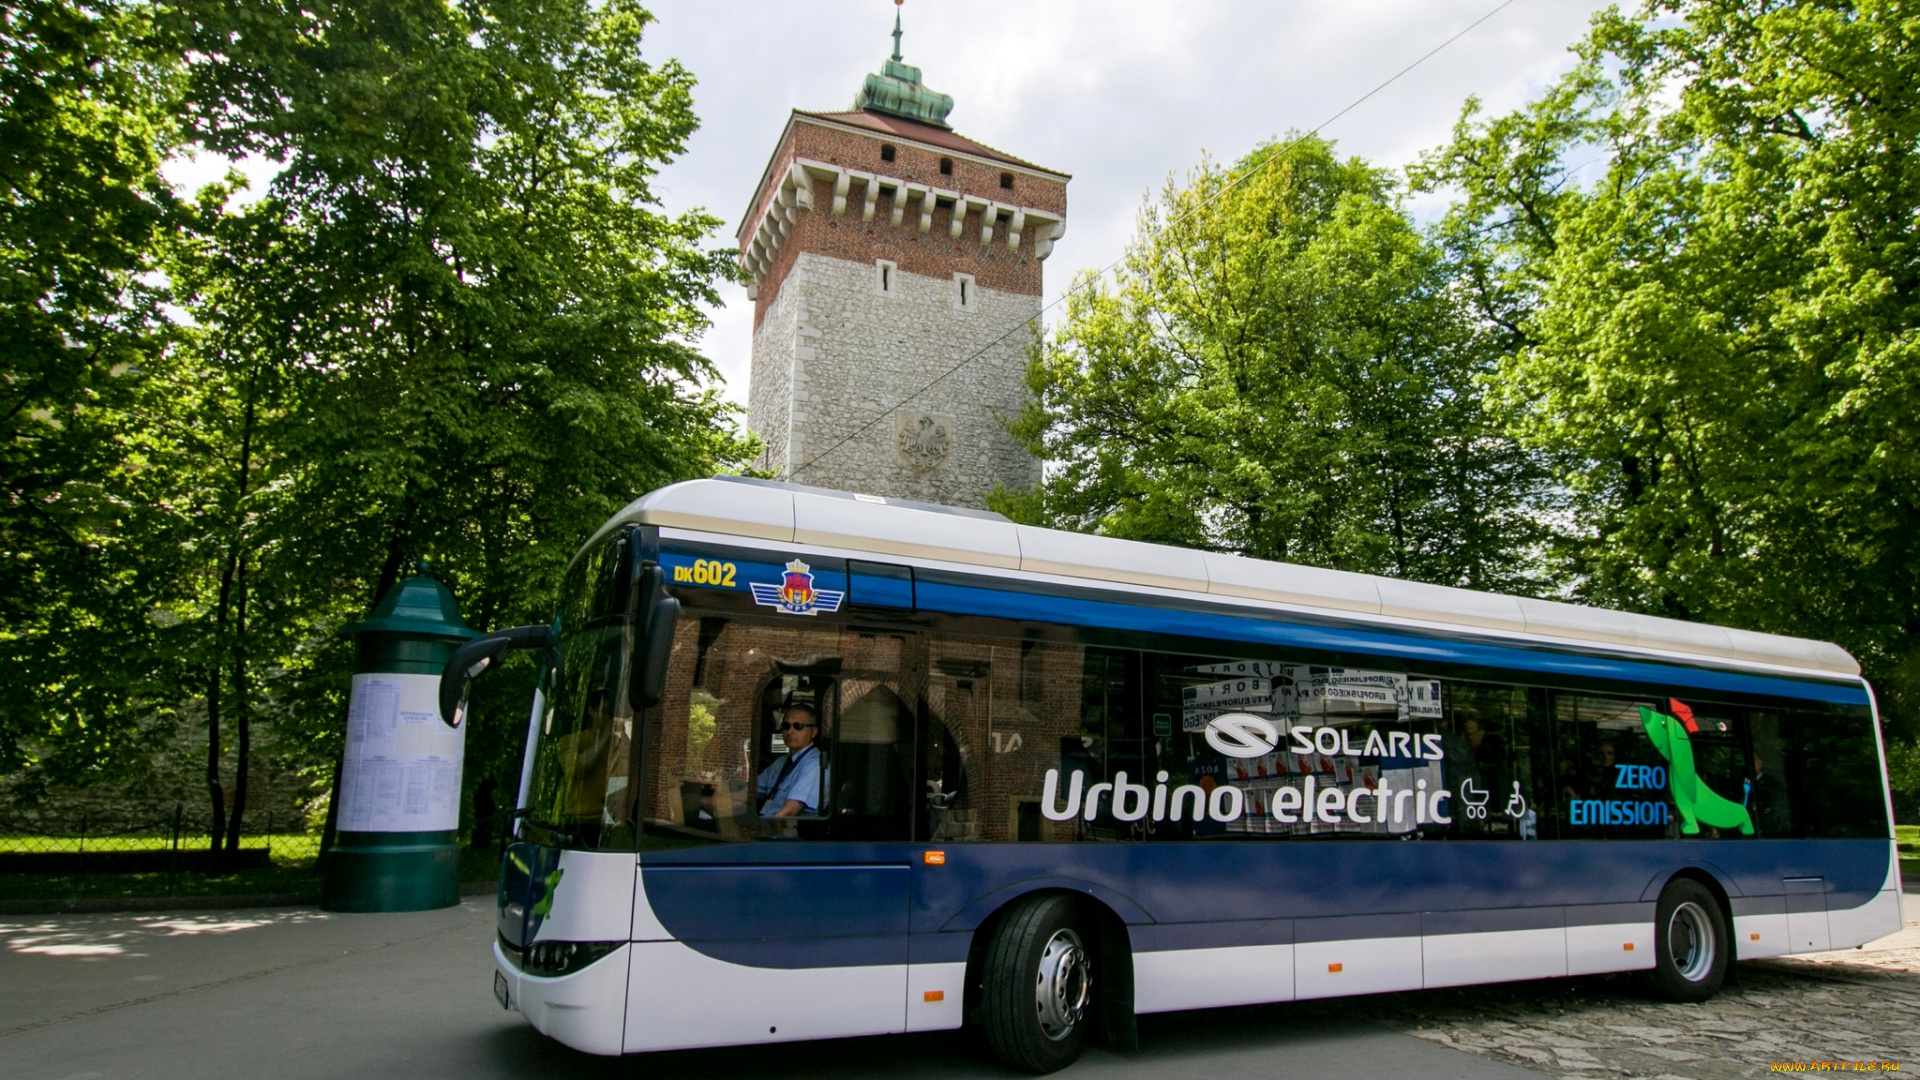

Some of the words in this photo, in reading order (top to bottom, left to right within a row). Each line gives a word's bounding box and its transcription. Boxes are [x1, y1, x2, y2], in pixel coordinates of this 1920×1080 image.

[674, 559, 736, 587] DK602
[786, 603, 808, 612] MPK
[1291, 726, 1444, 760] SOLARIS
[1615, 764, 1666, 790] ZERO
[1041, 769, 1243, 822] Urbino
[1272, 774, 1452, 824] electric
